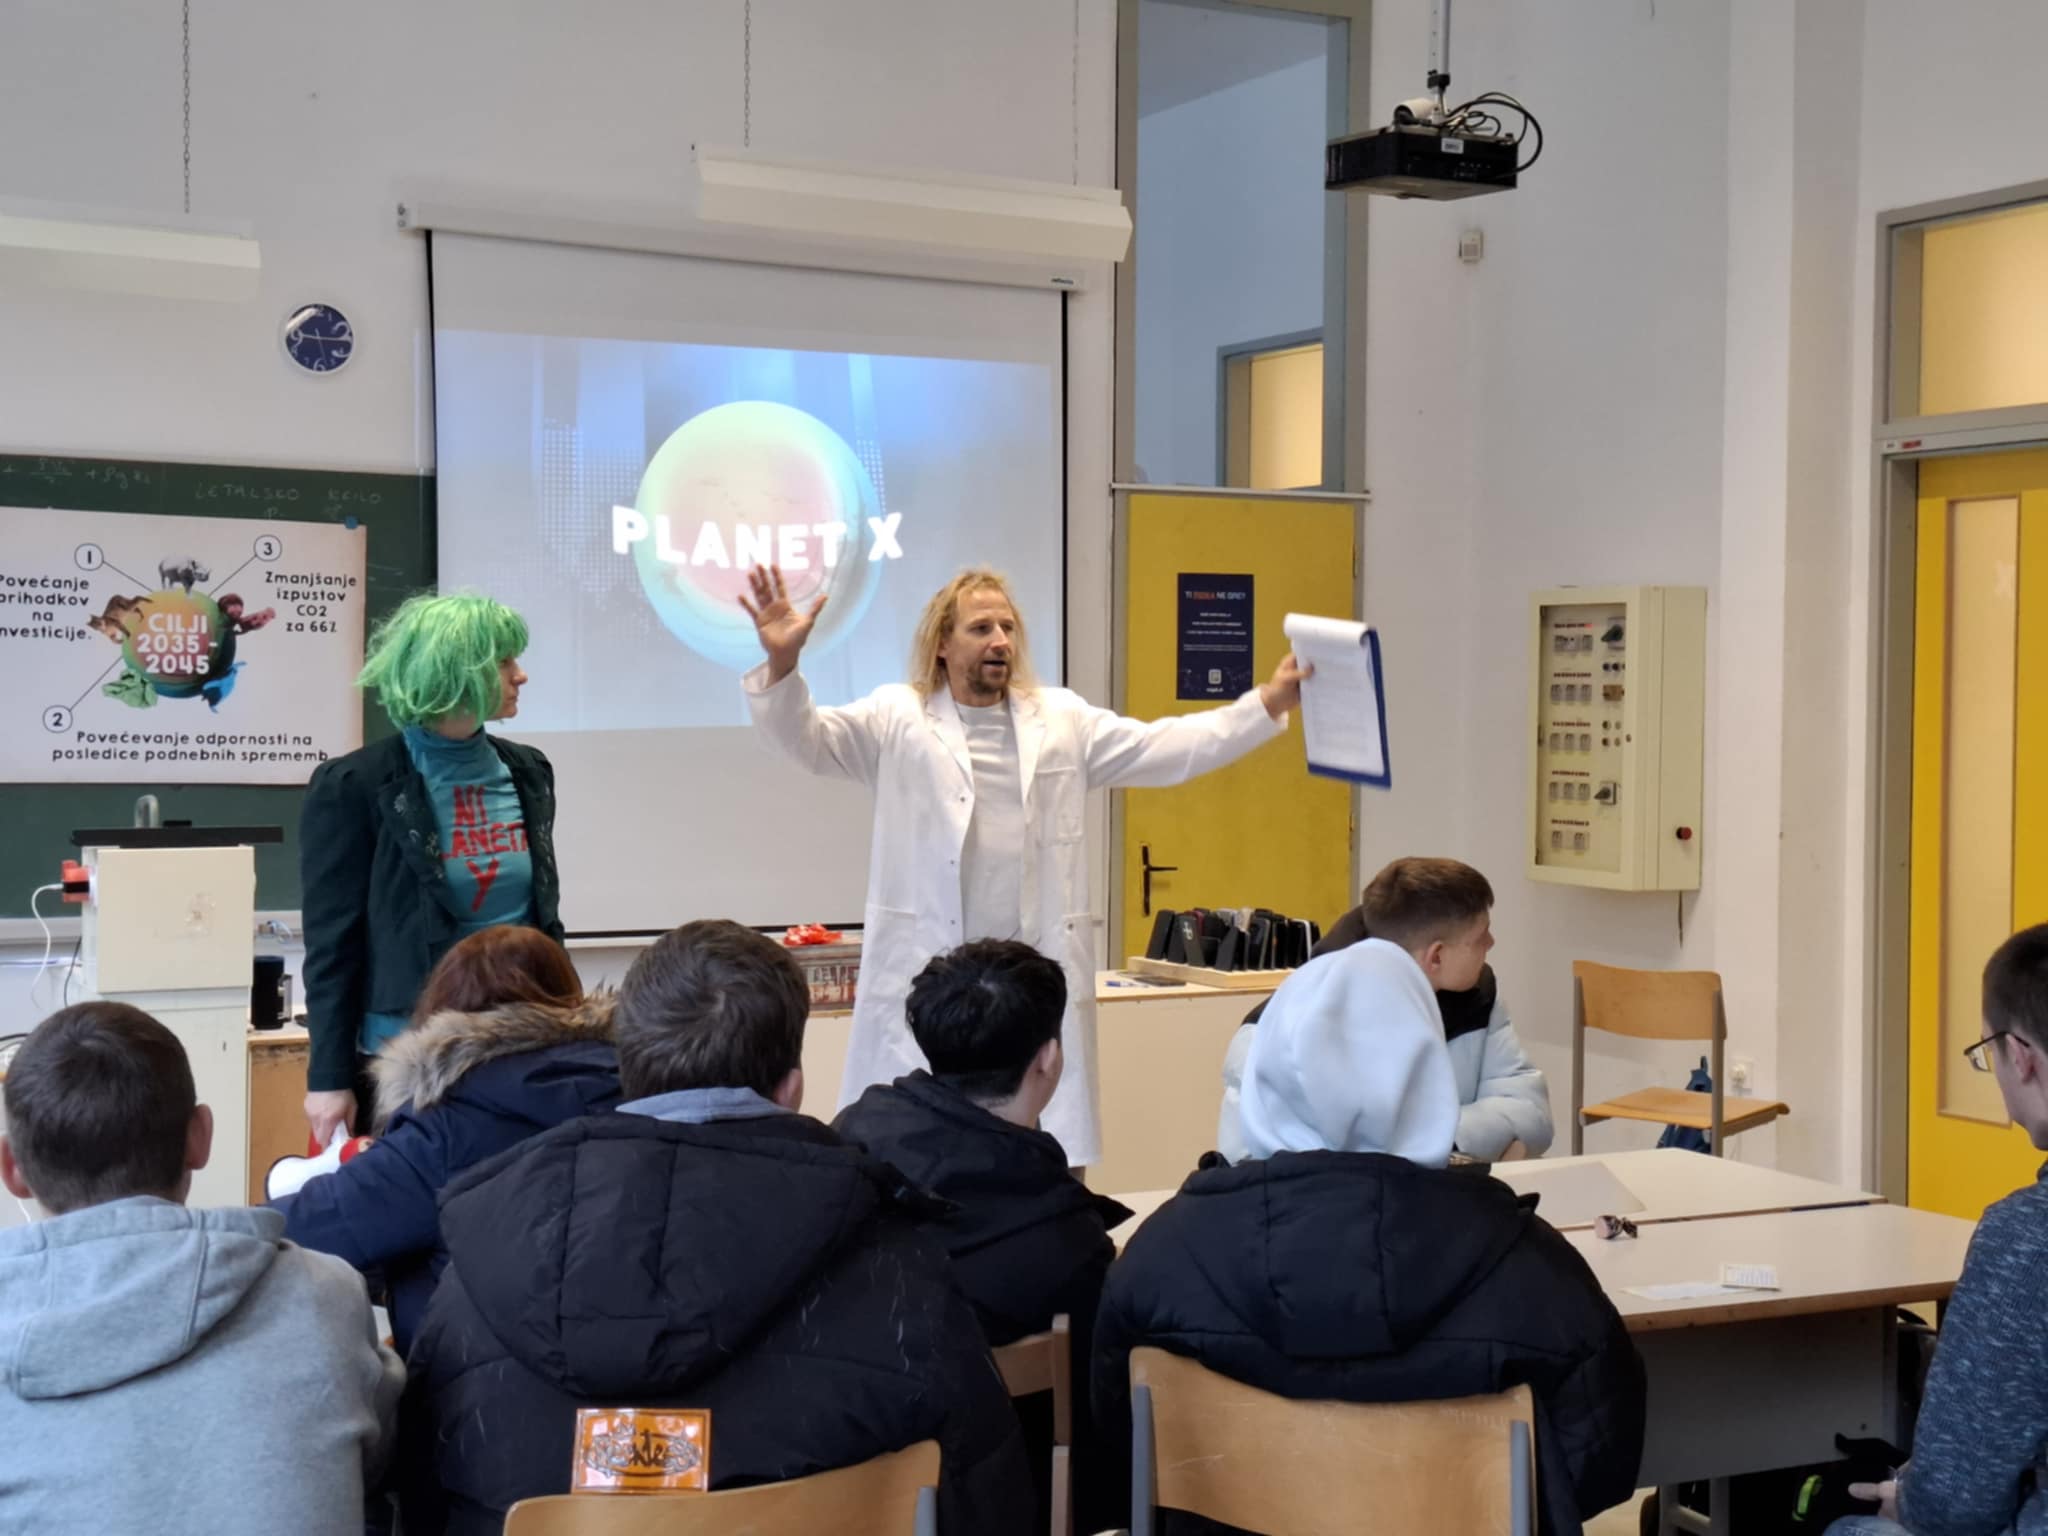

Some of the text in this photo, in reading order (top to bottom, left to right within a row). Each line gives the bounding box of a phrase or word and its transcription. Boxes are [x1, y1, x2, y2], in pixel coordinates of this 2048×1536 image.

[612, 505, 904, 571] PLANET X
[263, 541, 274, 556] 3
[276, 588, 346, 603] izpustov
[32, 611, 54, 622] na
[296, 603, 328, 617] CO2
[148, 612, 208, 635] CILJI
[286, 621, 305, 633] za
[0, 625, 92, 642] nvesticije.
[137, 633, 200, 654] 2035
[145, 653, 210, 675] 2045
[52, 712, 64, 727] 2
[195, 732, 288, 747] odpornosti
[292, 735, 313, 746] na
[53, 747, 328, 764] posledice podnebnih sprememb
[453, 784, 489, 827] NI
[465, 857, 500, 912] Y
